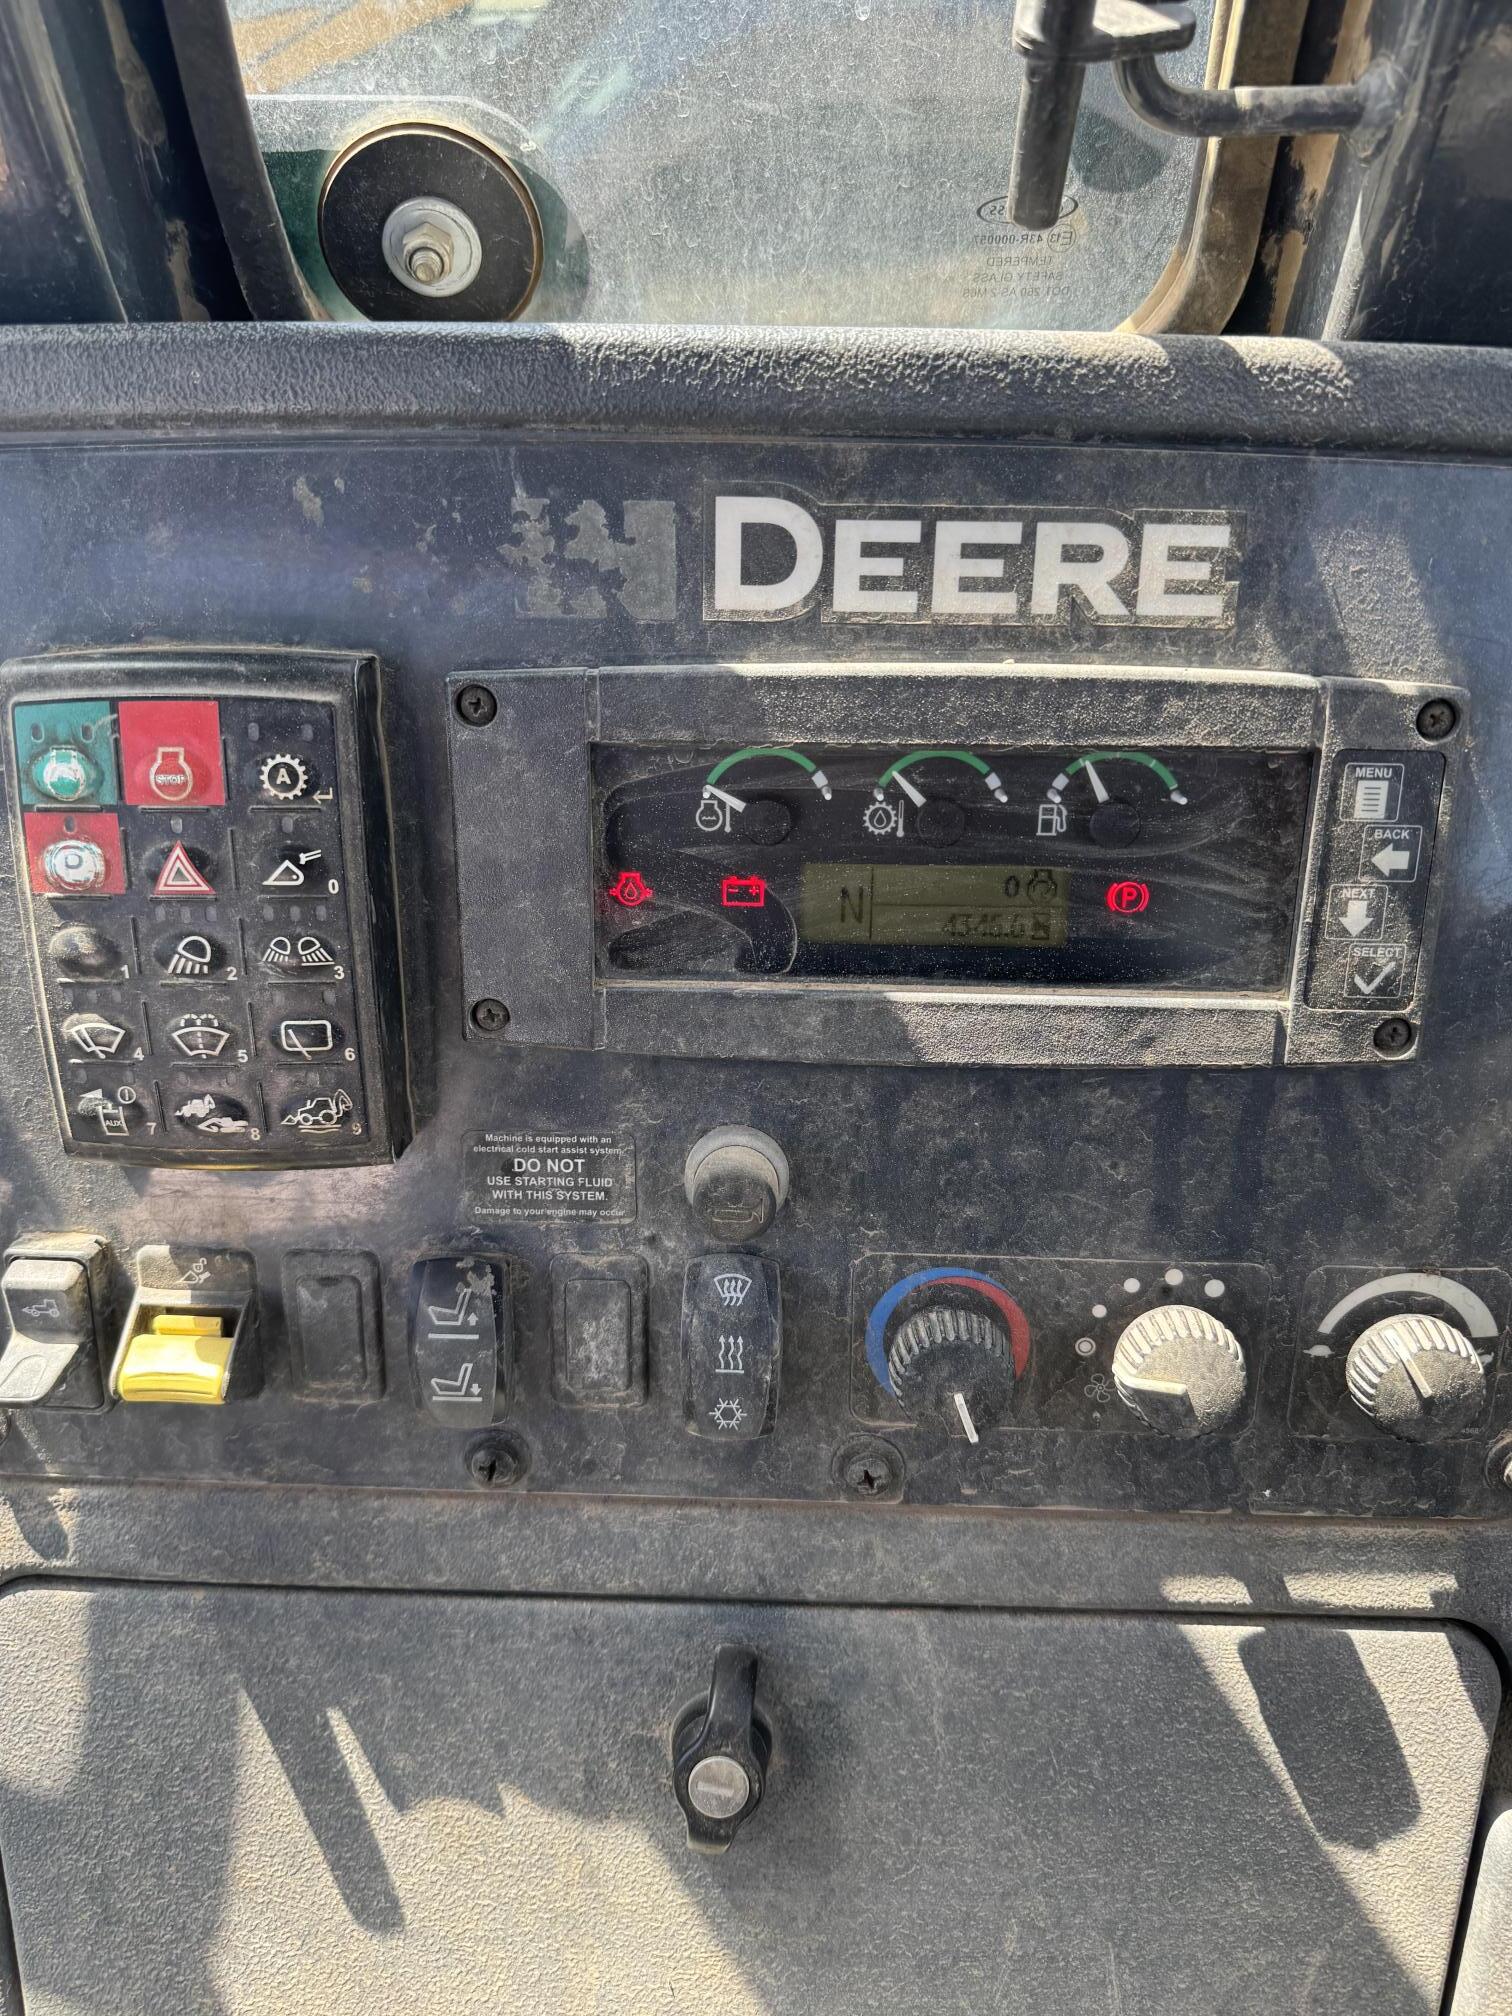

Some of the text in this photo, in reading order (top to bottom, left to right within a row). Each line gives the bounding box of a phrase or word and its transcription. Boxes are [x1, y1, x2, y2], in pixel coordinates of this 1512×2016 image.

[714, 495, 1230, 617] DEERE
[276, 767, 291, 785] A
[1355, 766, 1393, 778] MENU
[155, 773, 185, 785] STOP
[1374, 828, 1410, 840] BACK
[327, 878, 339, 895] 0
[1121, 886, 1138, 908] P
[1341, 888, 1375, 899] NEXT
[840, 884, 864, 924] N
[1352, 947, 1401, 958] SELECT
[121, 966, 130, 979] 1
[226, 966, 238, 981] 2
[333, 966, 345, 980] 3
[133, 1047, 145, 1061] 4
[237, 1049, 248, 1063] 5
[344, 1048, 356, 1062] 6
[105, 1119, 123, 1127] AUX
[147, 1122, 156, 1135] 7
[352, 1122, 362, 1136] 9
[250, 1127, 261, 1141] 8
[485, 1133, 612, 1145] Machine is equipped with an
[473, 1144, 514, 1153] electrical
[516, 1145, 536, 1154] cold
[537, 1146, 559, 1154] start
[560, 1146, 588, 1154] assist
[513, 1158, 586, 1173] DO NOT
[487, 1176, 613, 1188] USE STARTING FLUID
[492, 1189, 608, 1201] WITH THIS SYSTEM.
[474, 1206, 511, 1217] Damage
[513, 1207, 522, 1216] to
[524, 1208, 545, 1217] your
[546, 1208, 577, 1217] engine
[578, 1209, 598, 1218] may
